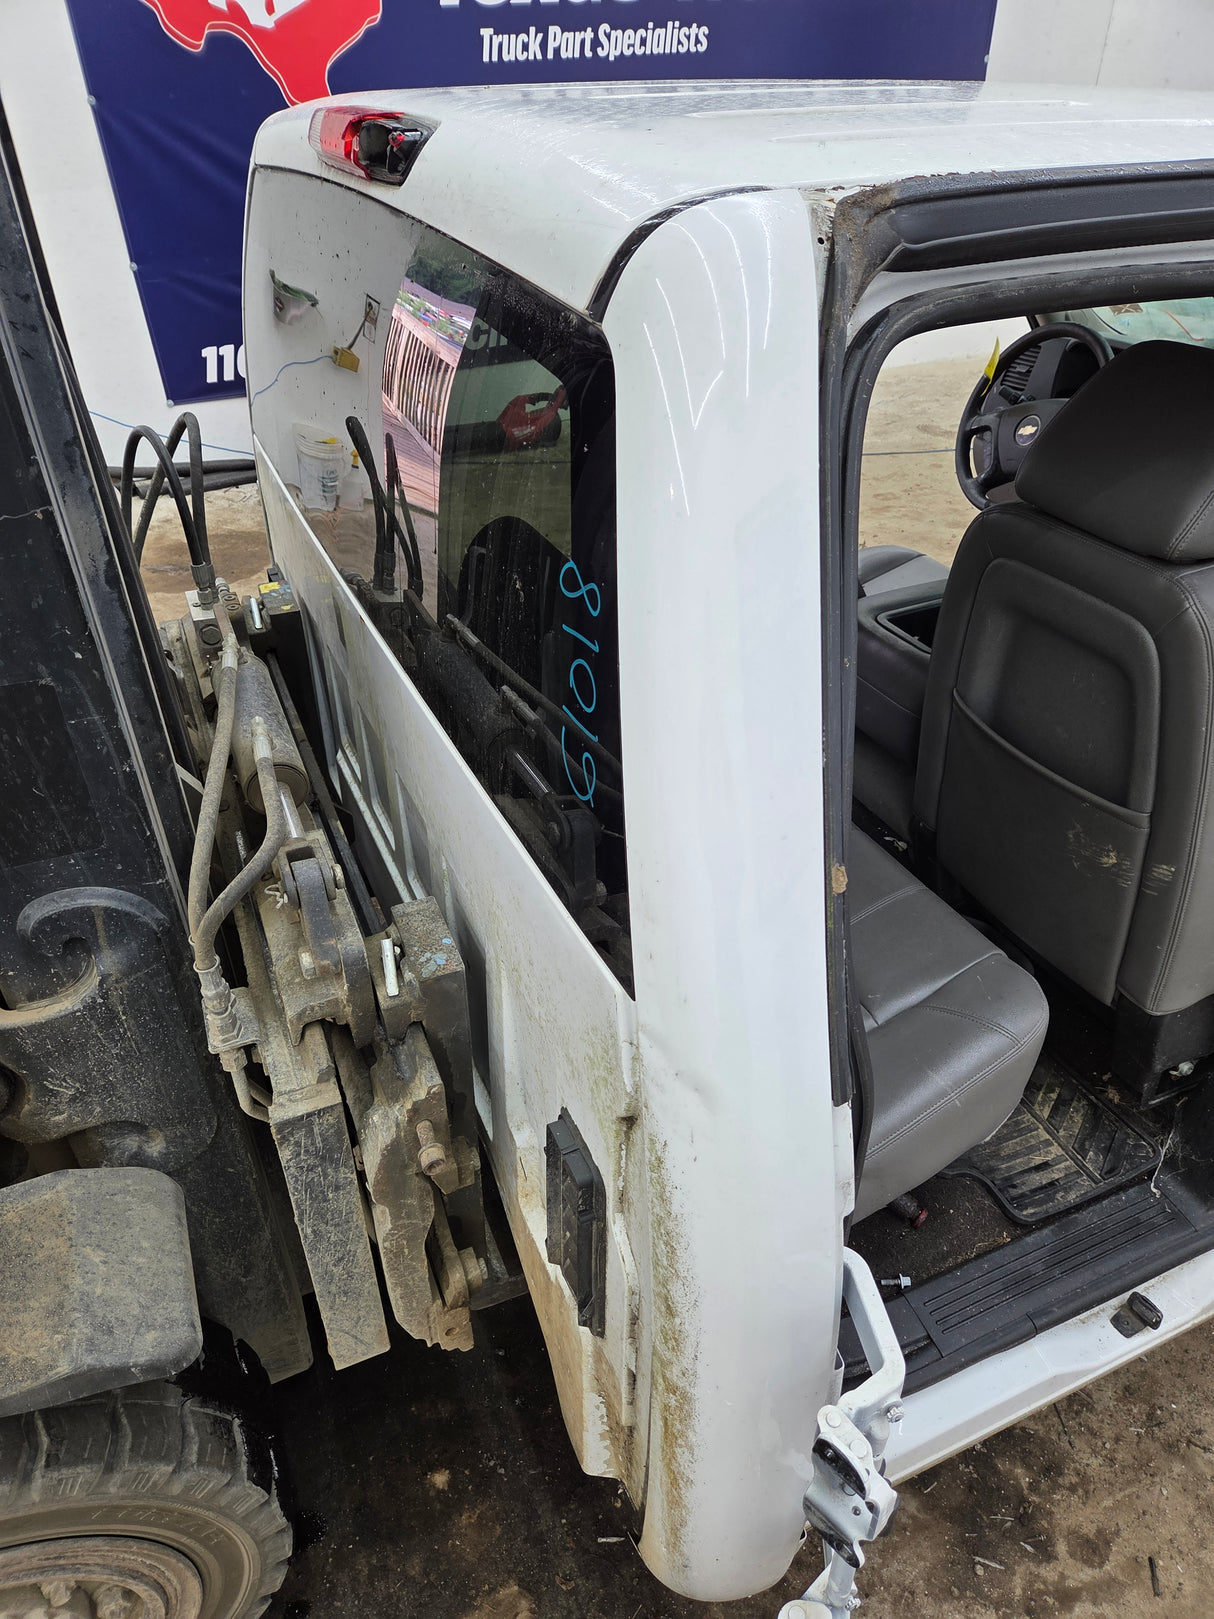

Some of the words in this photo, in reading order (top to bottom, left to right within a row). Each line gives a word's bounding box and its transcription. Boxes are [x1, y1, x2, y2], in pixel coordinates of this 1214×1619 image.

[480, 26, 543, 62] Truck
[547, 25, 594, 59] Part
[597, 21, 709, 61] Specialists
[559, 559, 601, 808] 81019
